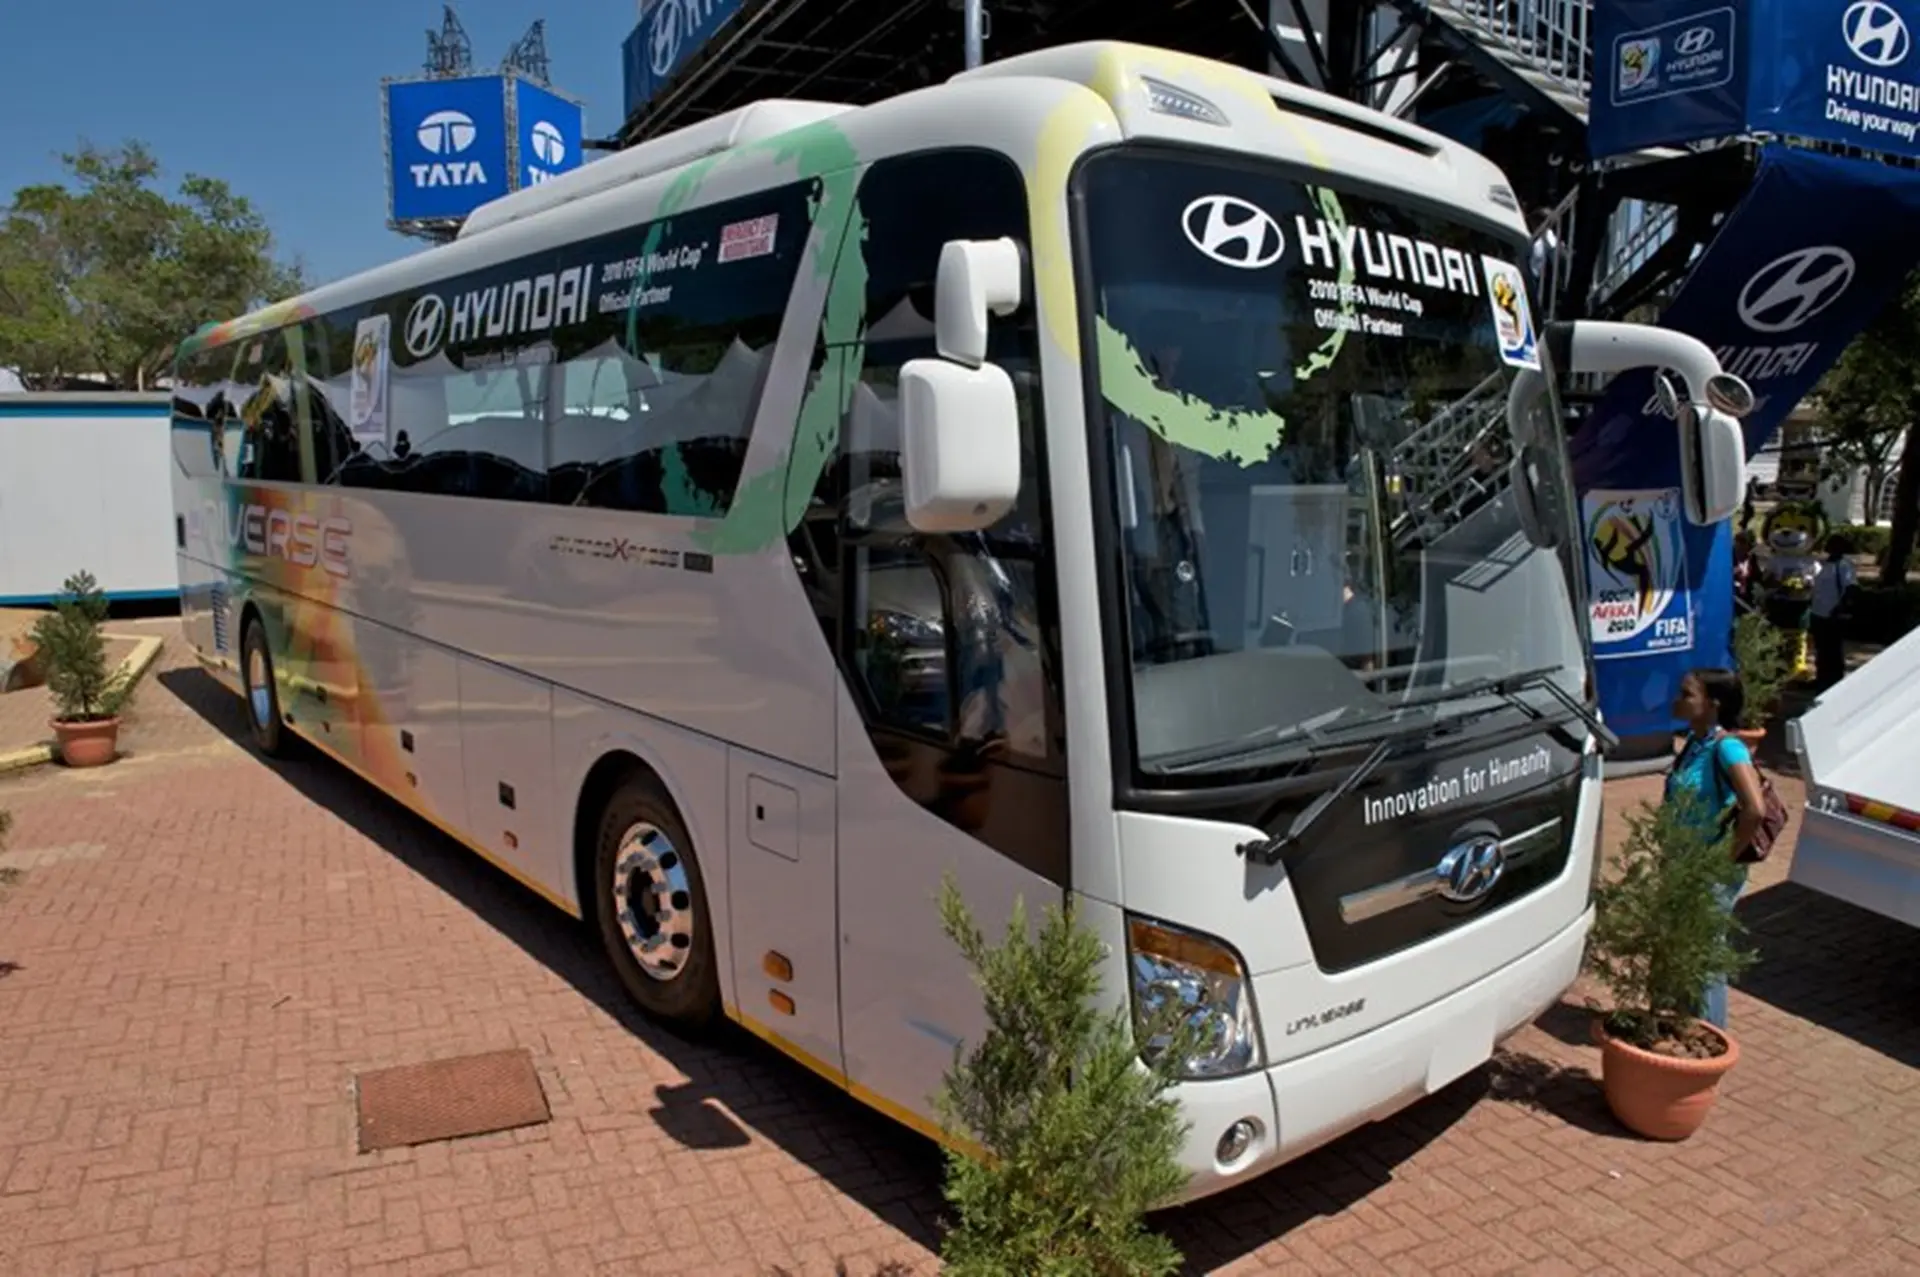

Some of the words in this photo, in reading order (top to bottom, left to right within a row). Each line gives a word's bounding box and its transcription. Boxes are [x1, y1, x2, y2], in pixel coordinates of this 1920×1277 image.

[1827, 64, 1920, 114] HYUNDAI
[1825, 98, 1860, 127] Drive
[1862, 112, 1890, 133] your
[1891, 119, 1916, 143] way
[410, 161, 487, 187] TATA
[646, 248, 680, 274] World
[1295, 215, 1480, 297] HYUNDAI
[450, 264, 594, 343] HYUNDAI
[1308, 278, 1338, 300] 2010
[1366, 287, 1402, 311] World
[1402, 292, 1423, 318] Cup
[1314, 307, 1361, 331] Official
[1361, 314, 1404, 337] Partner
[1607, 618, 1636, 633] 2010
[1655, 617, 1687, 637] FIFA
[1364, 775, 1460, 825] Innovation
[1463, 766, 1488, 795] for
[1489, 744, 1551, 788] Humanity
